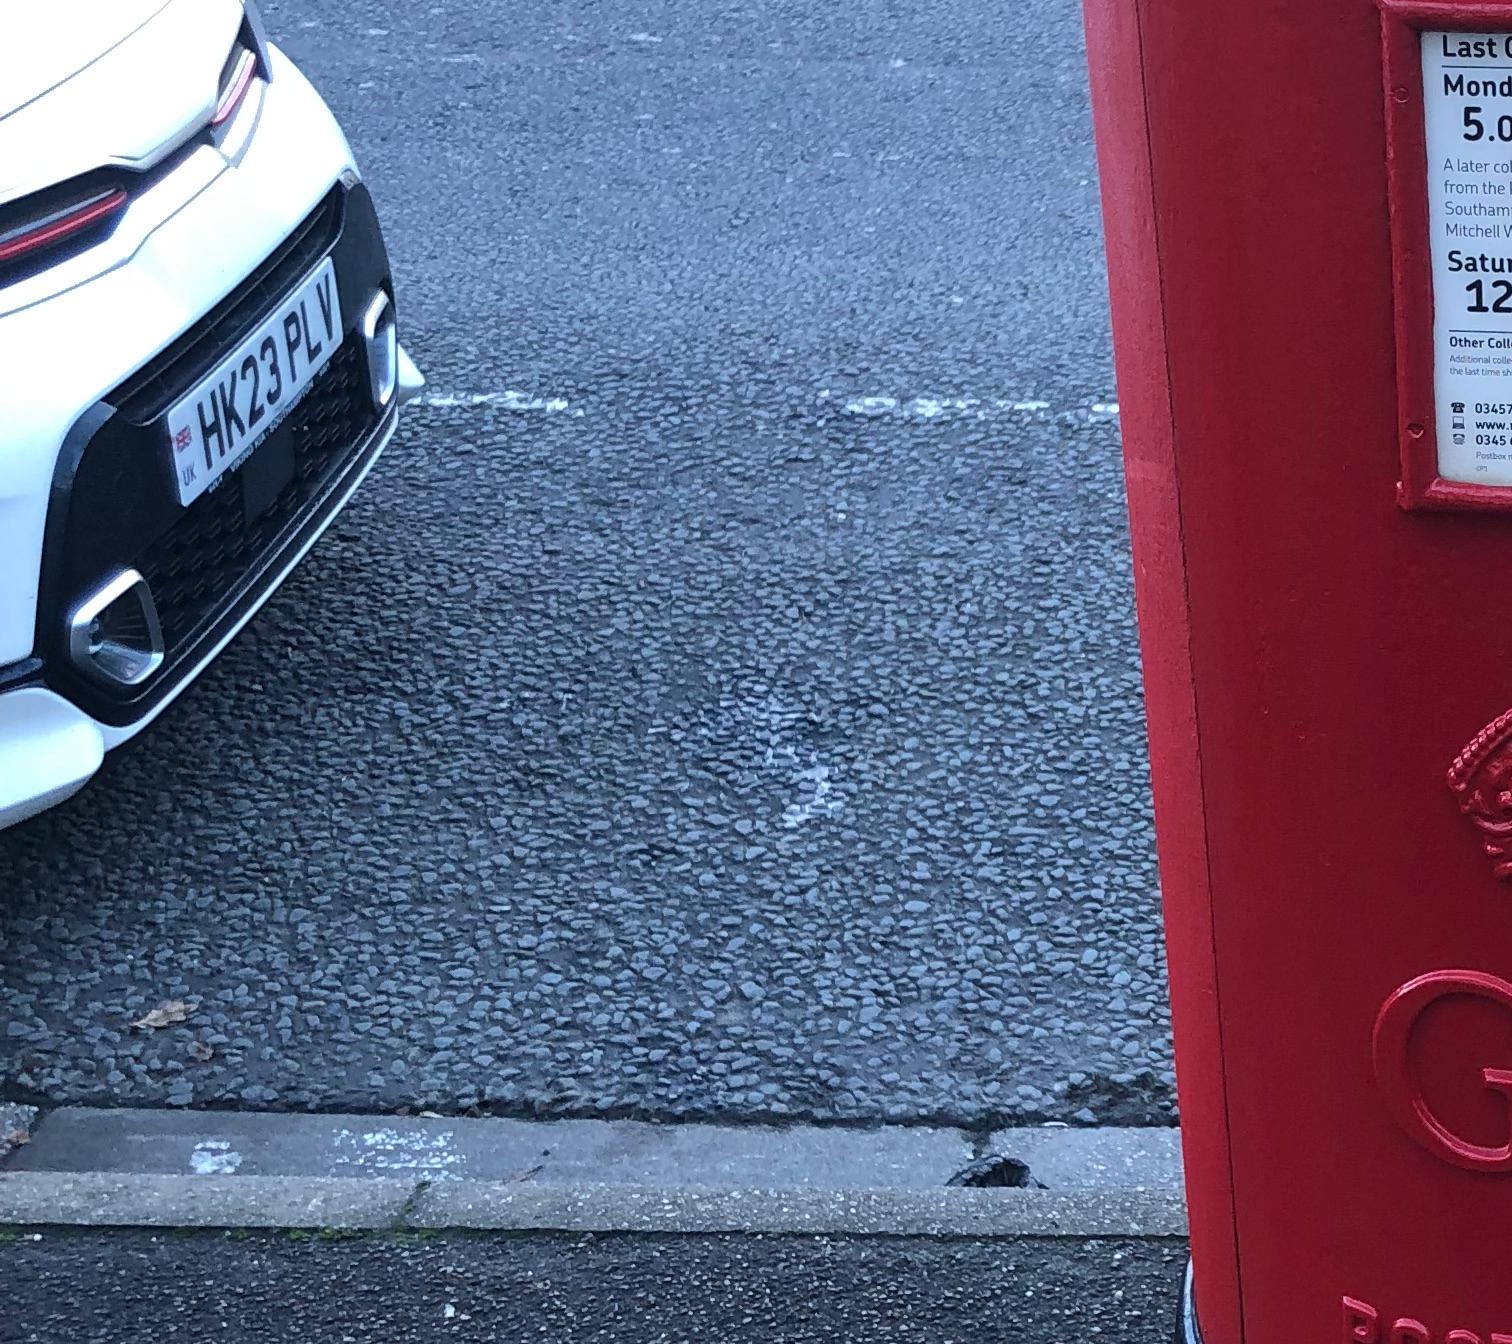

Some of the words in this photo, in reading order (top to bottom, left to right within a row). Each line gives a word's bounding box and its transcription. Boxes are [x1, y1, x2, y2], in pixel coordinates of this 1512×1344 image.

[1442, 35, 1498, 58] Last
[1444, 158, 1453, 171] A
[1458, 159, 1490, 172] later
[1444, 180, 1478, 194] from
[1483, 181, 1505, 194] the
[1446, 223, 1500, 238] Mitchell
[1466, 279, 1512, 313] 12
[1450, 336, 1484, 348] Other
[196, 335, 283, 472] HK23
[283, 273, 334, 385] PLV
[1475, 403, 1512, 414] 03457
[1476, 435, 1506, 446] 0345
[182, 463, 198, 486] UK
